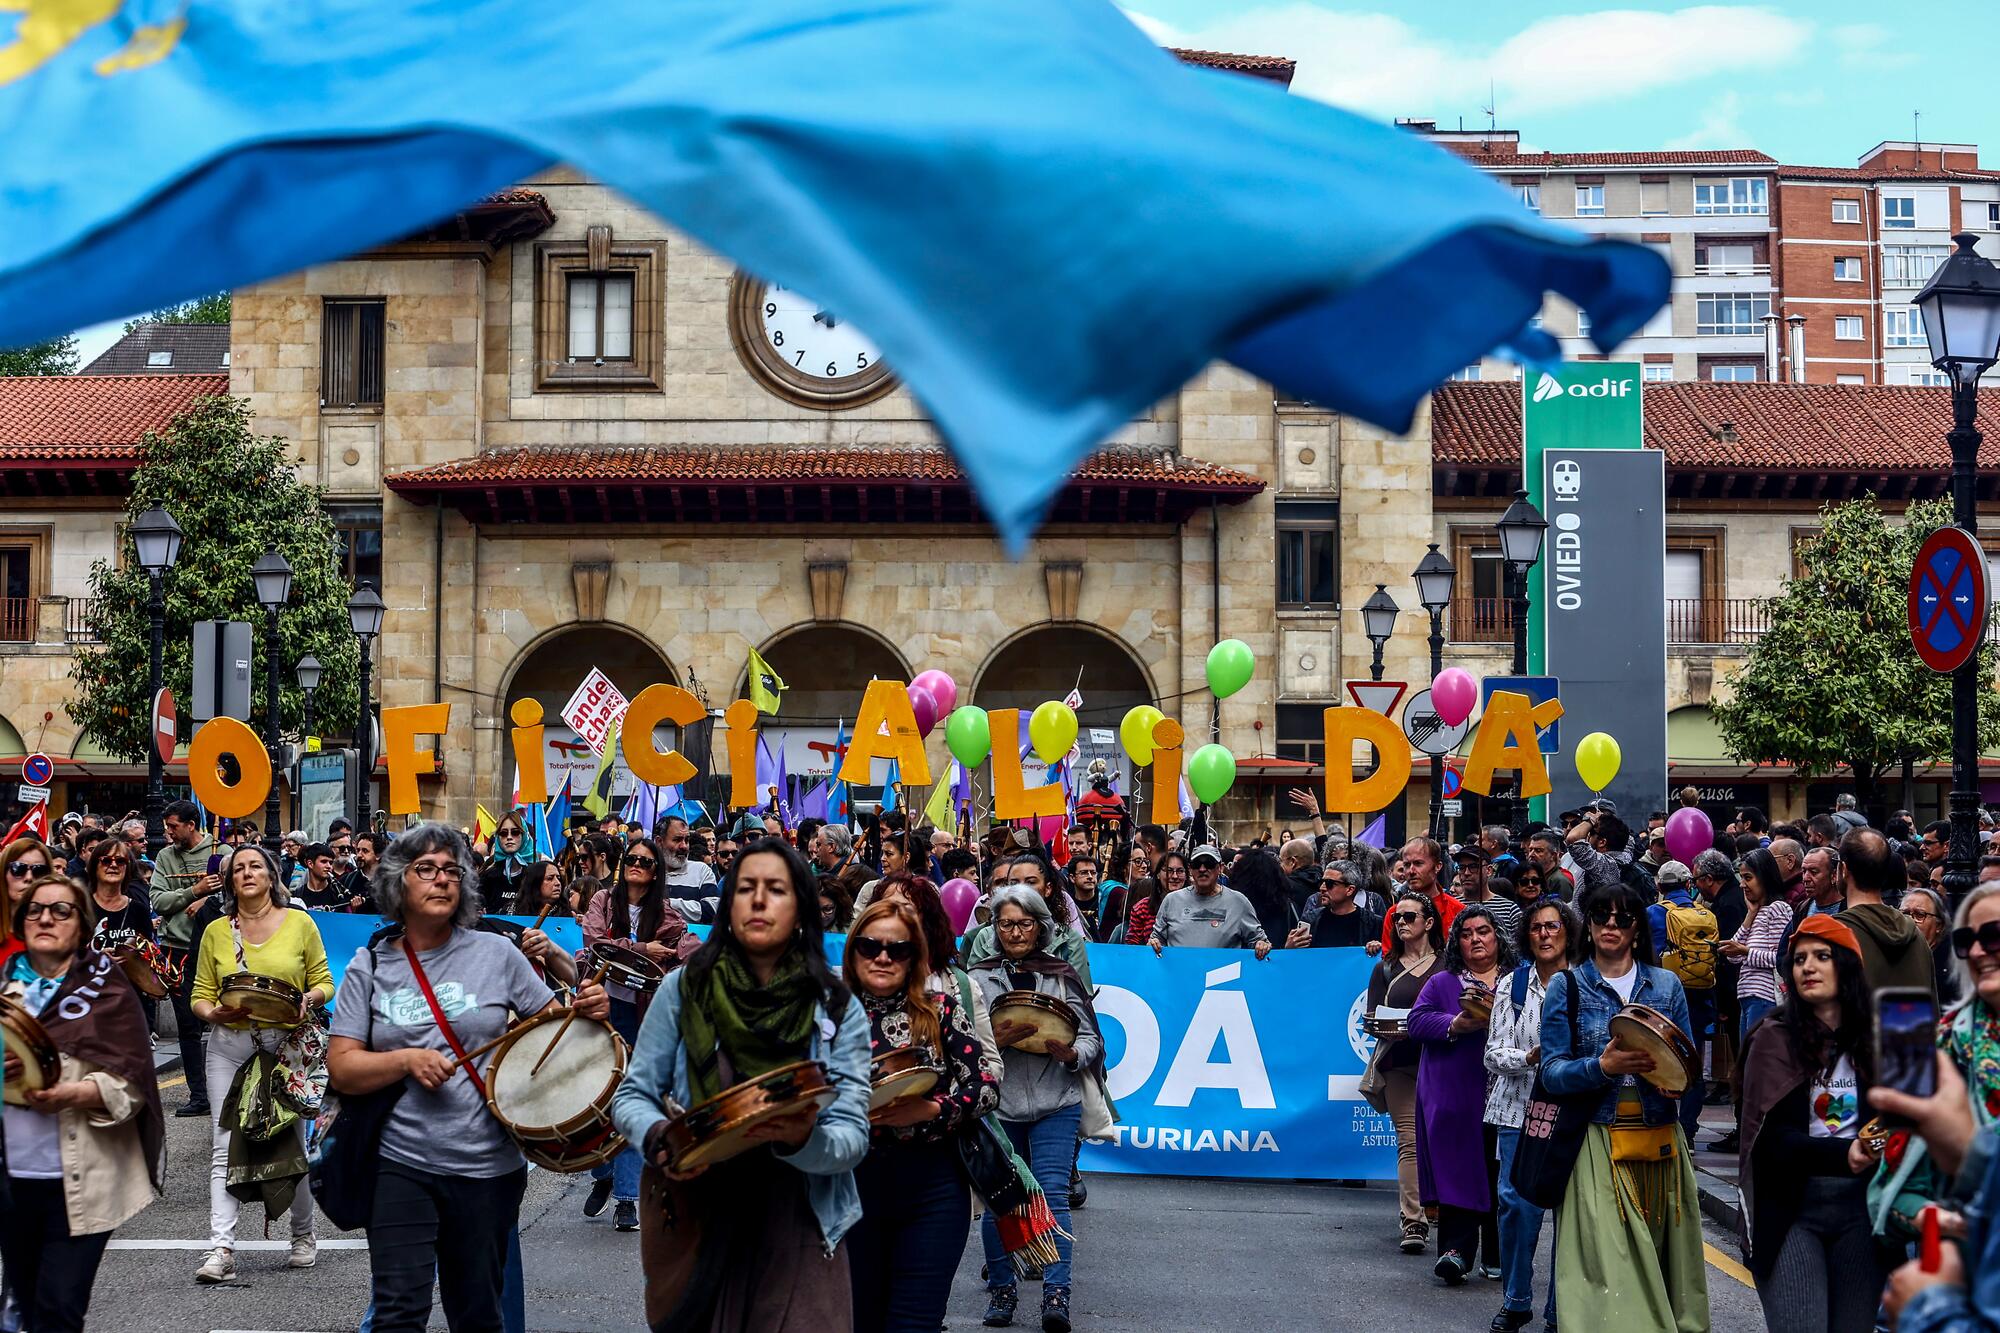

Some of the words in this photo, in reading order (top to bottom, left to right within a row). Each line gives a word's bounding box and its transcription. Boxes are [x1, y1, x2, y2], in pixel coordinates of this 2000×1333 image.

[766, 303, 777, 318] 9
[773, 331, 784, 347] 8
[795, 350, 806, 367] 7
[857, 352, 868, 369] 5
[826, 362, 837, 377] 6
[1567, 378, 1633, 397] adif
[1556, 512, 1582, 611] OVIEDO
[571, 680, 608, 729] ande
